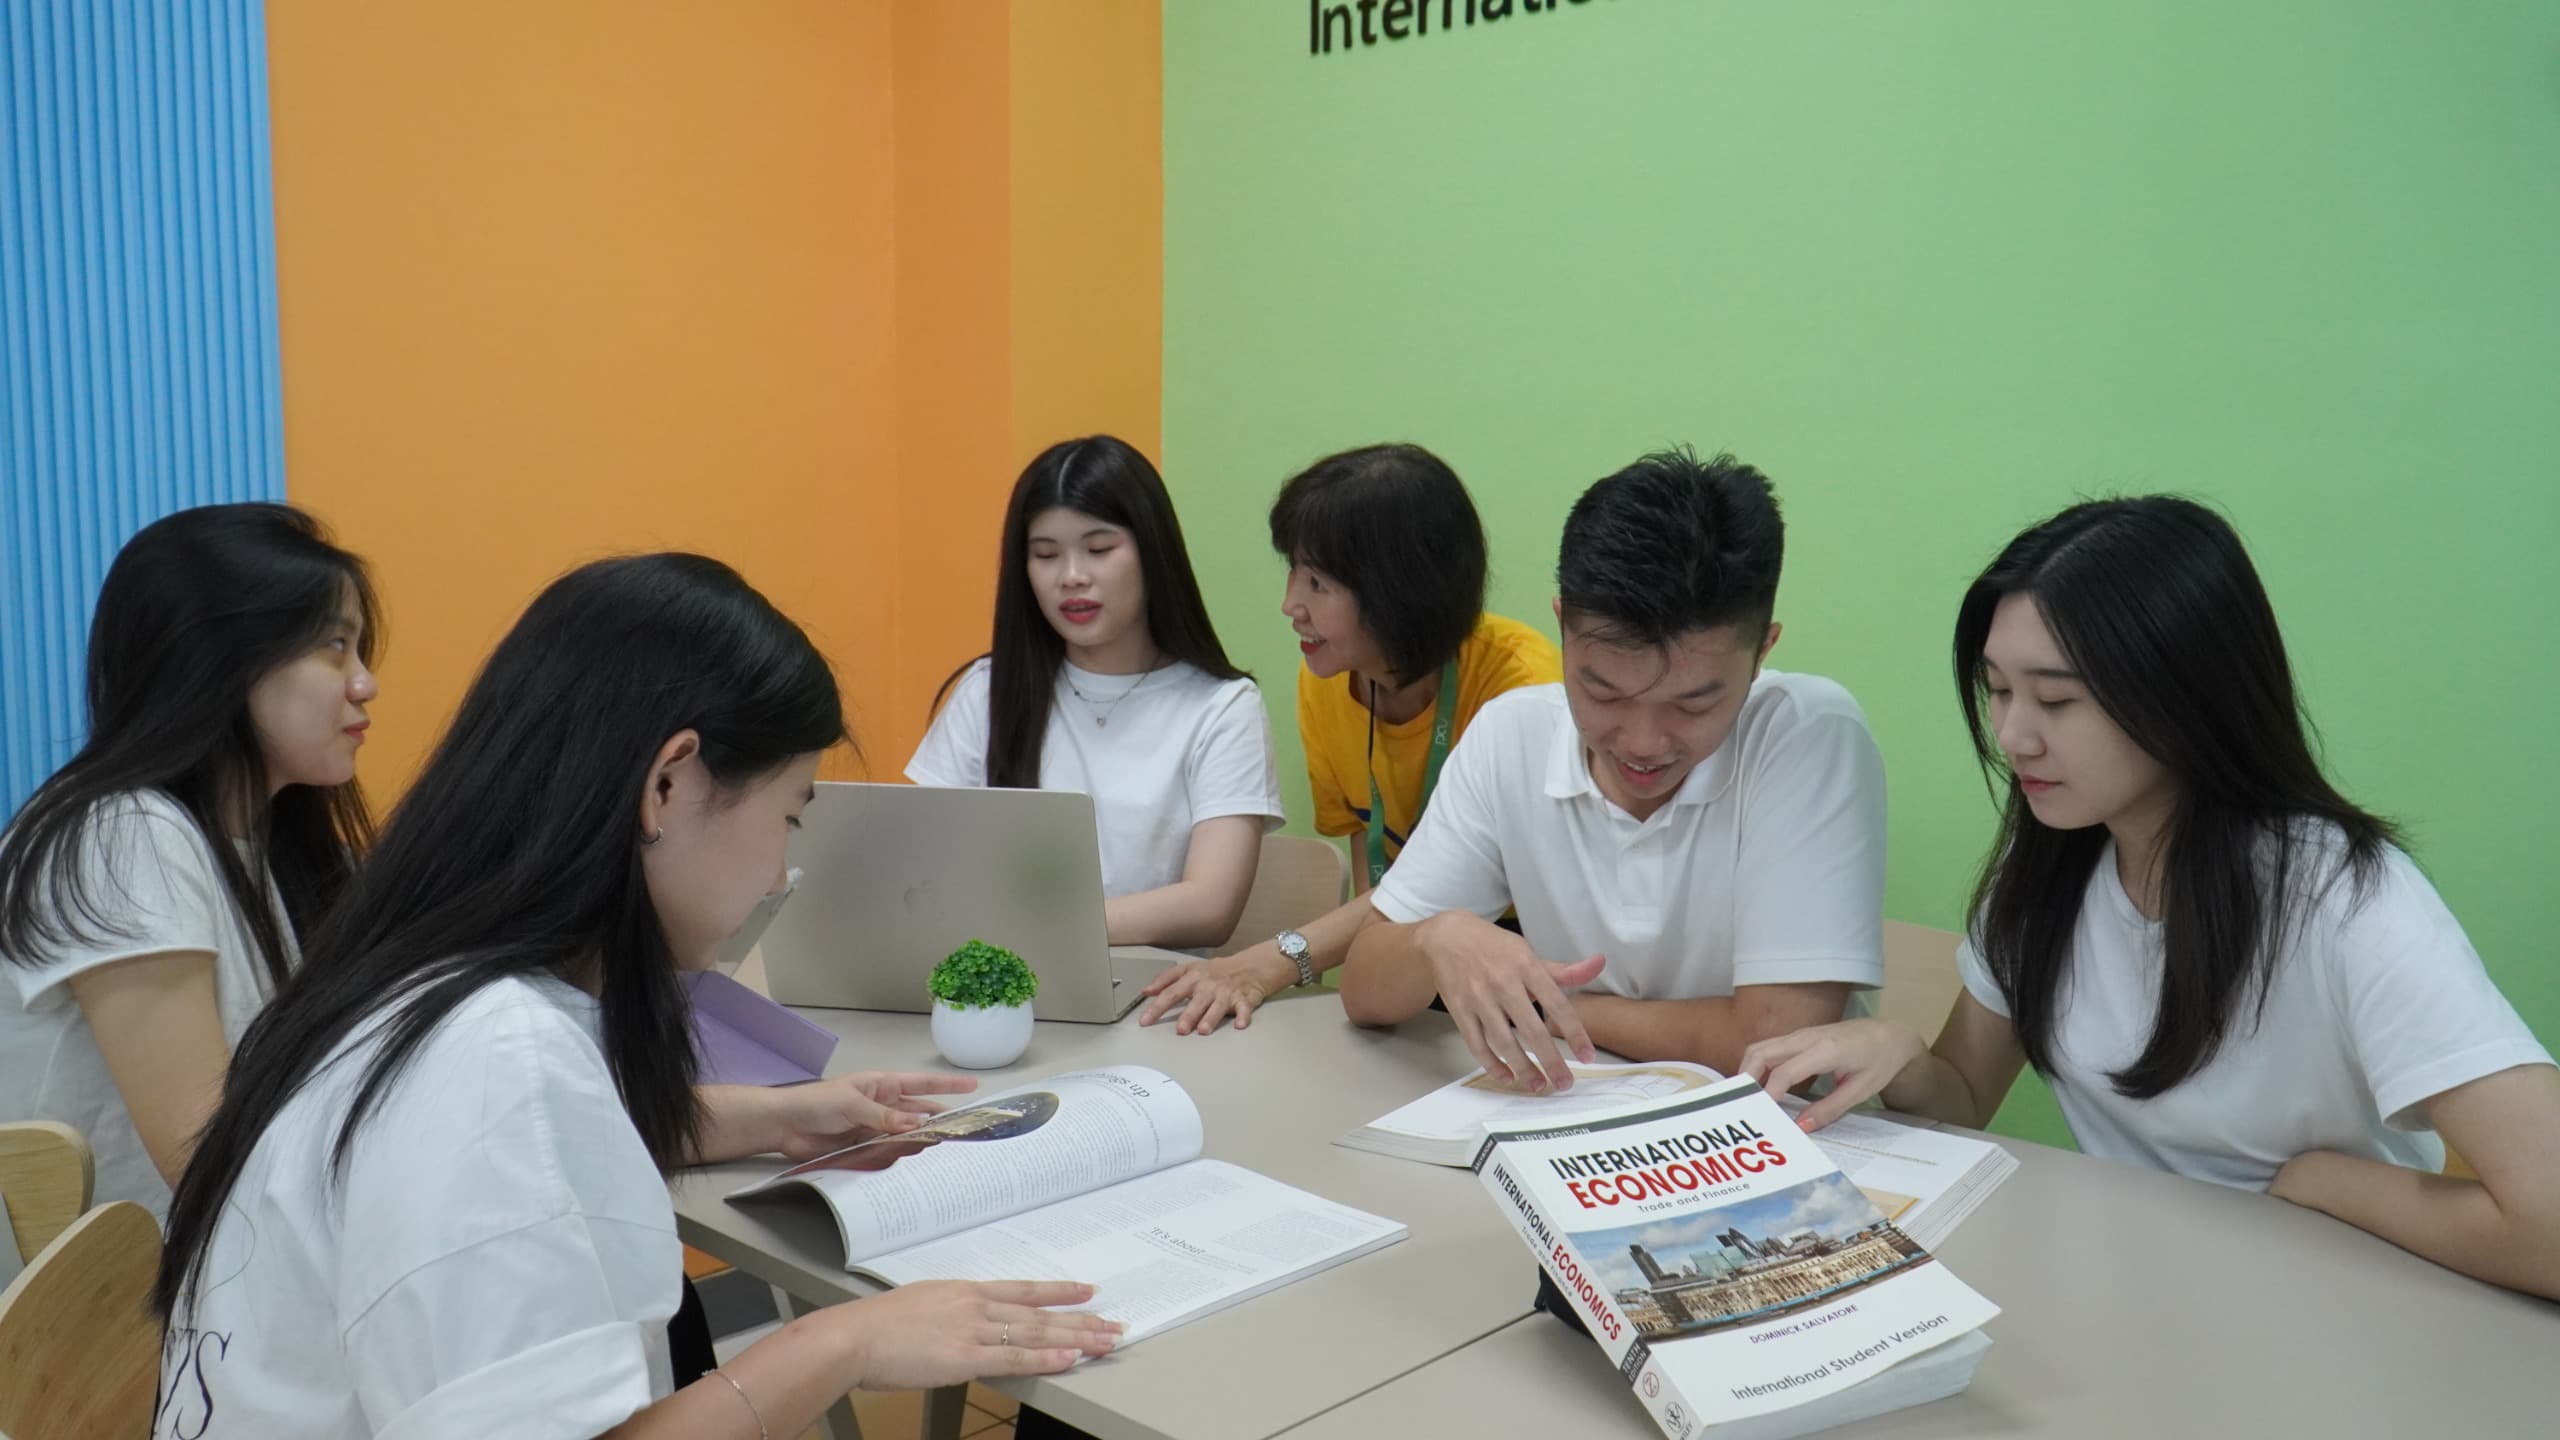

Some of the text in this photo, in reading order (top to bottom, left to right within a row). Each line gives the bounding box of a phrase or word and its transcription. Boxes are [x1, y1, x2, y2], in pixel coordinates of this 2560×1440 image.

[1549, 1127, 1591, 1139] EDITION
[1549, 1120, 1764, 1180] INTERNATIONAL
[1567, 1140, 1787, 1209] ECONOMICS
[1637, 1183, 1751, 1213] Trade and Finance
[1493, 1162, 1622, 1341] INTERNATIONAL ECONOMICS
[1750, 1304, 1859, 1344] DOMINICK SALVATORE
[1731, 1313, 1949, 1400] International Student Version
